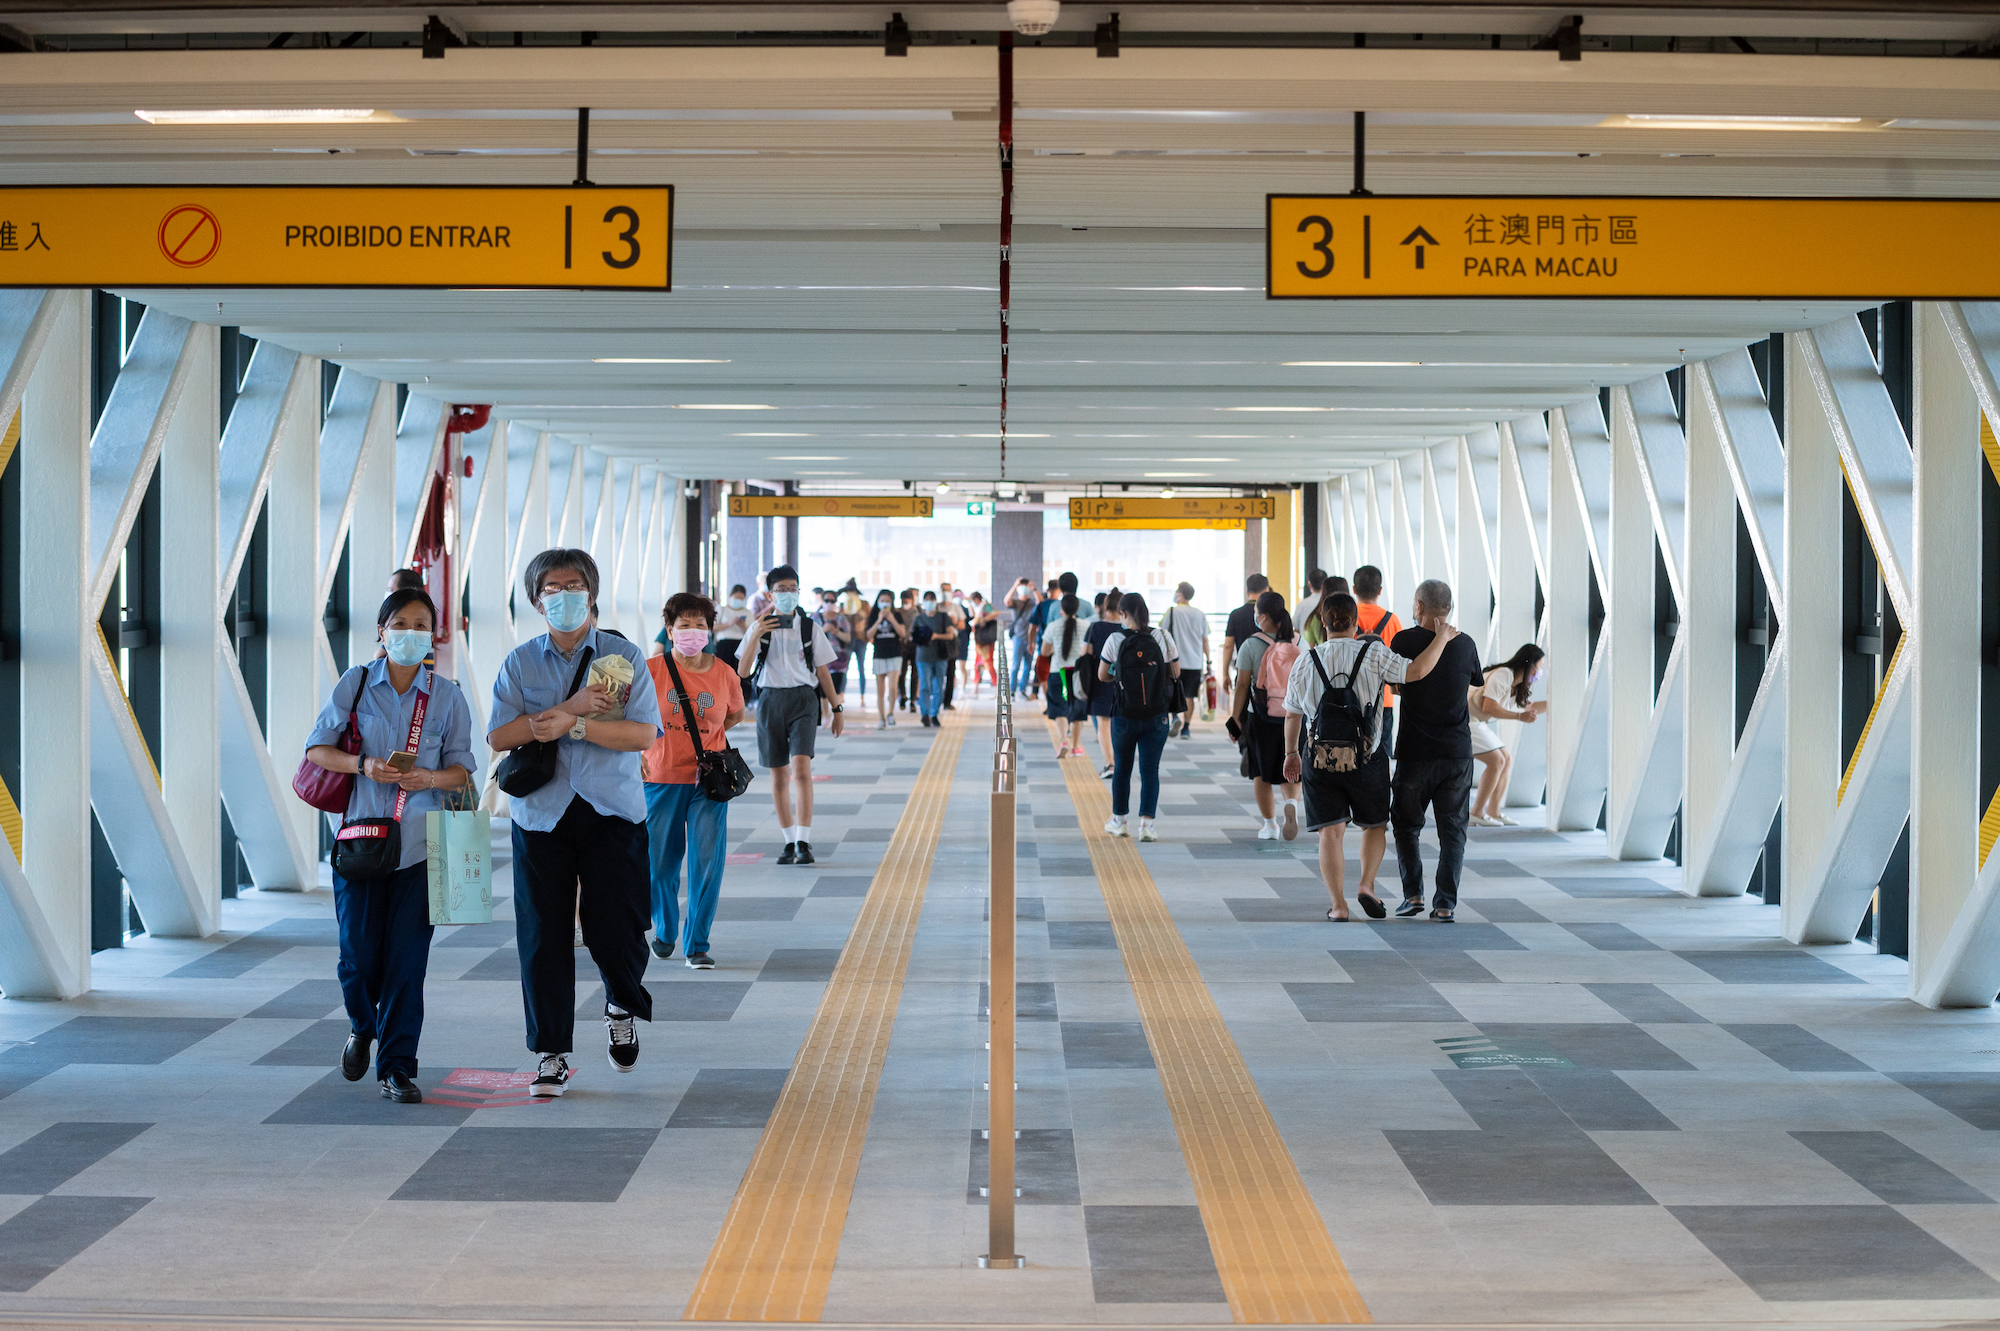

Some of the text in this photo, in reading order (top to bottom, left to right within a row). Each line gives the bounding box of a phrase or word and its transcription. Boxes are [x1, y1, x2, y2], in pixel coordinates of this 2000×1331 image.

[285, 225, 511, 248] PROIBIDO ENTRAR
[601, 205, 641, 269] 3
[1463, 213, 1638, 246] 往澳門市區
[1296, 215, 1335, 279] 3
[1464, 257, 1618, 277] PARA MACAU
[733, 499, 743, 513] 3
[919, 500, 928, 514] 3
[1074, 501, 1083, 515] 3
[1260, 501, 1269, 515] 3
[409, 726, 421, 745] BAG
[396, 790, 407, 818] MENG
[341, 826, 379, 838] MENGHUO
